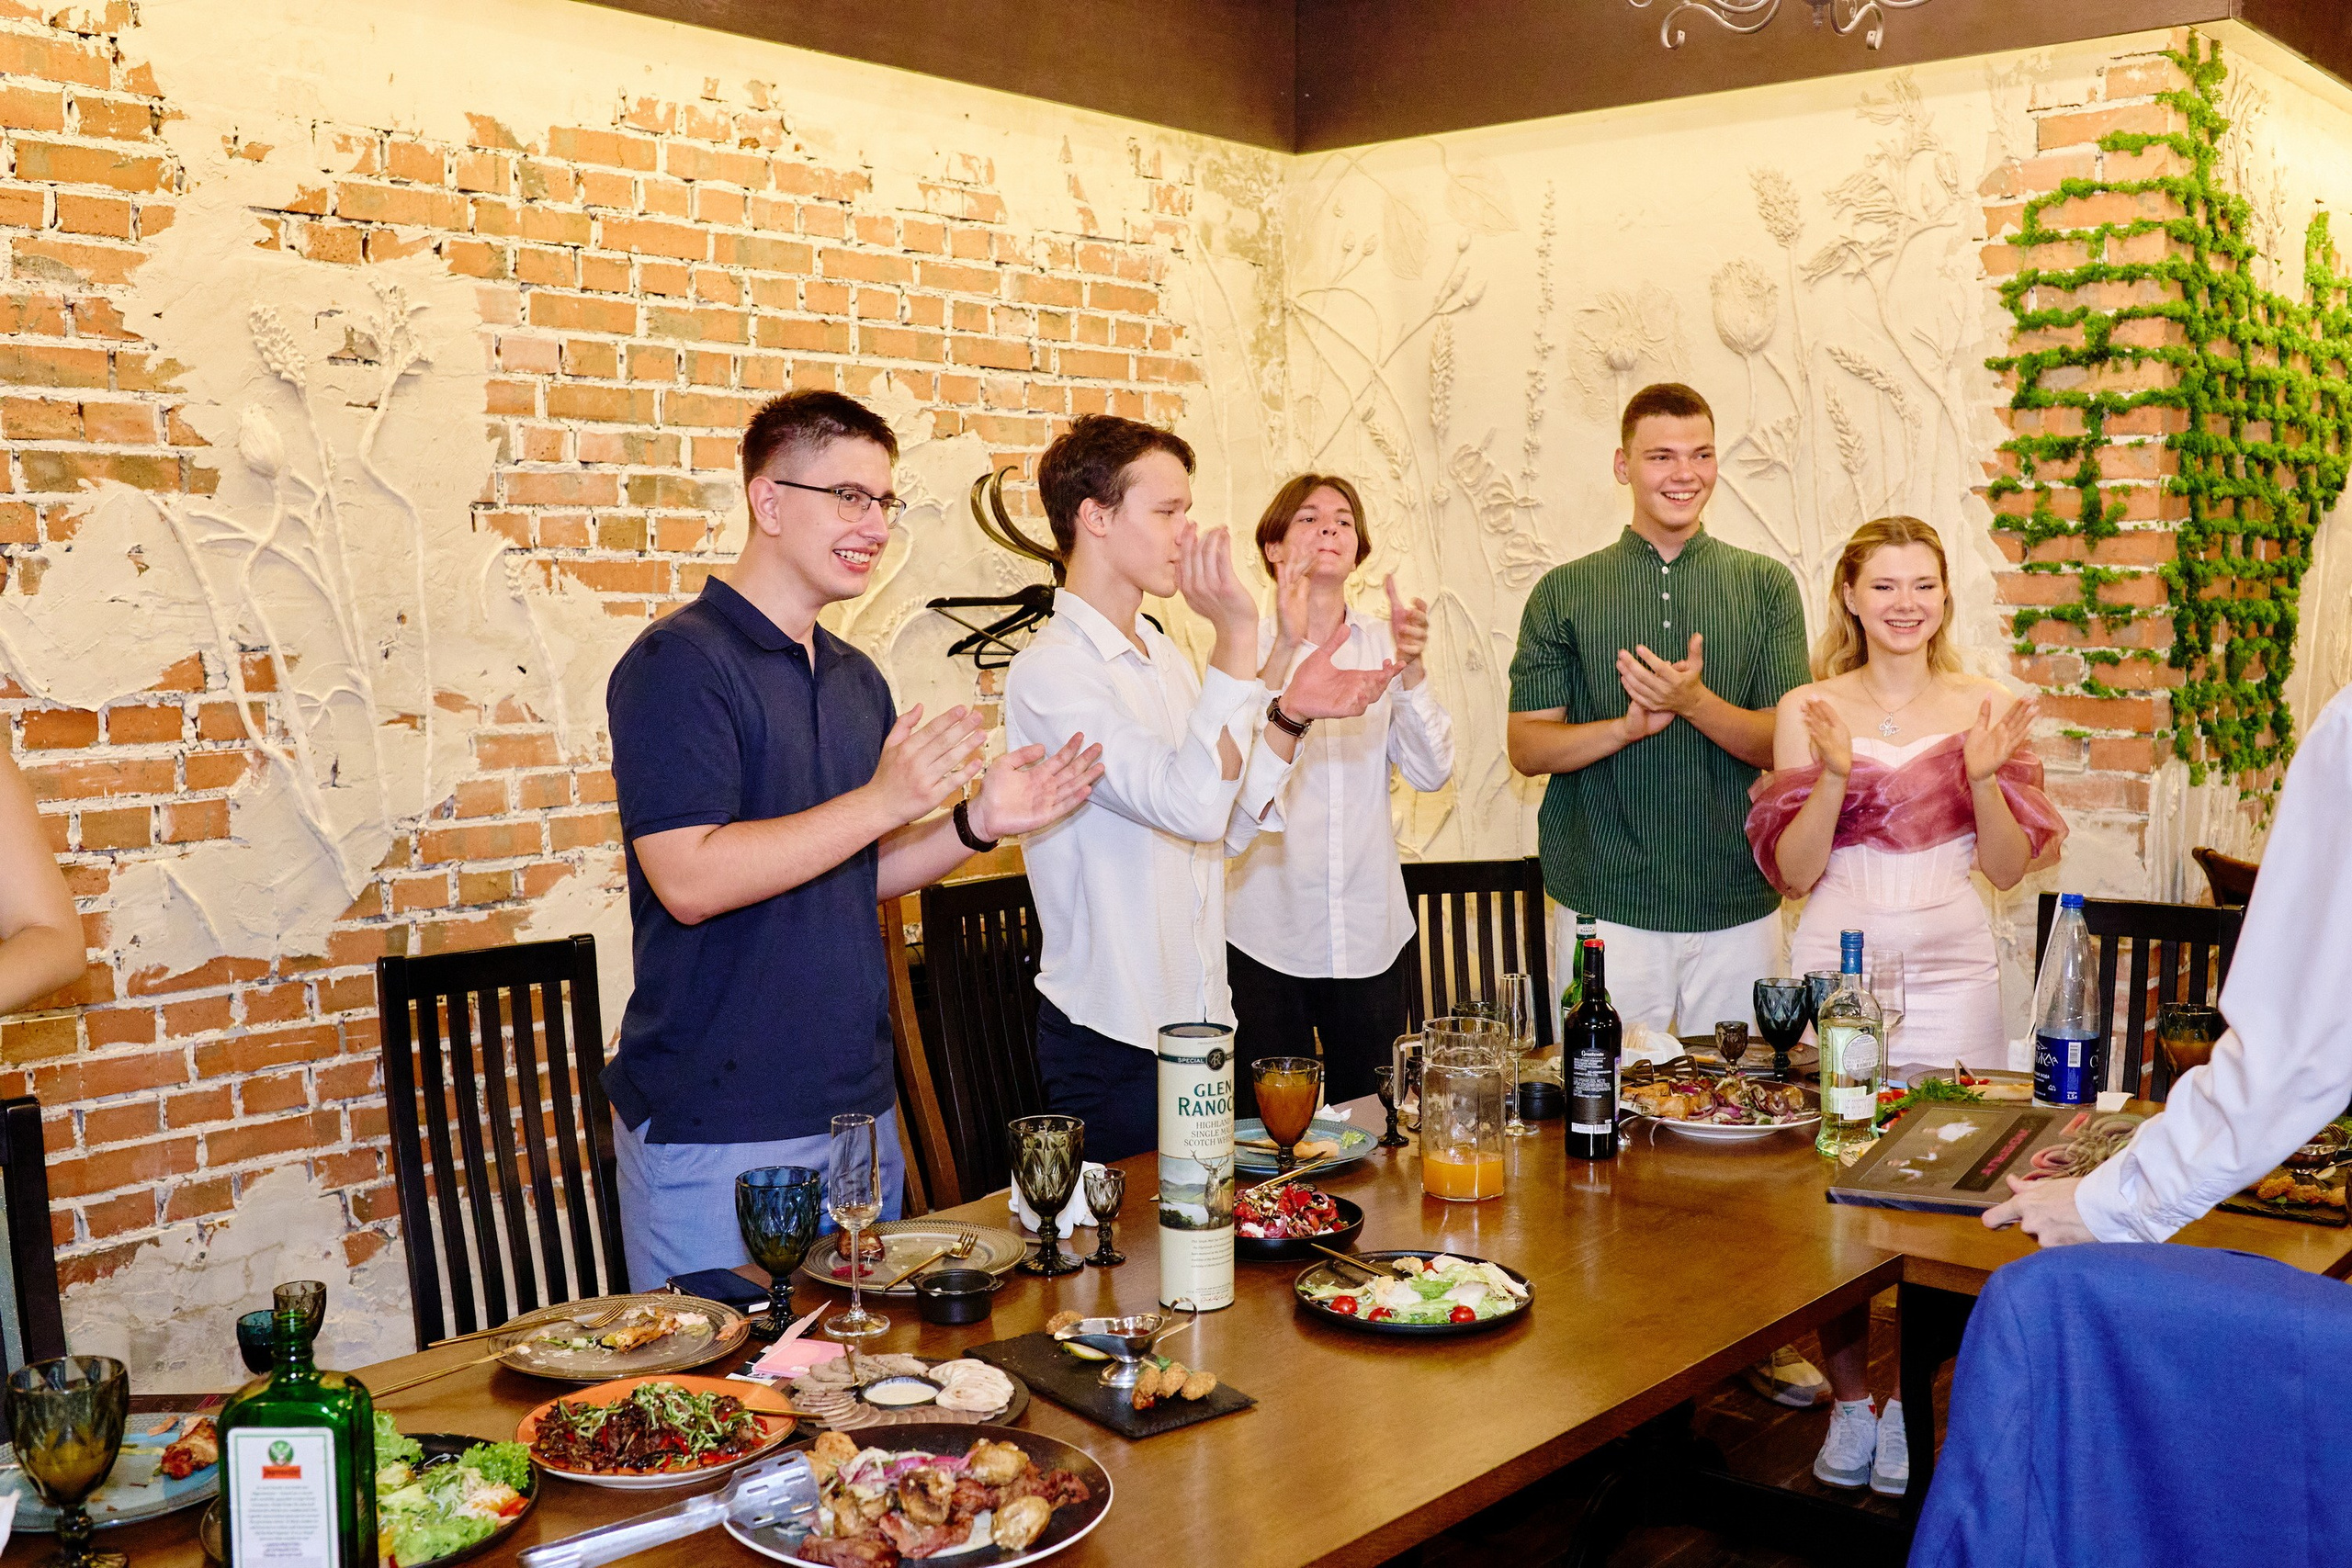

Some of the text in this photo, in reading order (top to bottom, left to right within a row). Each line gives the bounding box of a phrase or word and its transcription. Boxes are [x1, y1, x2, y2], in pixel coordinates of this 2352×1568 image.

[1193, 1078, 1232, 1098] GLEN
[1191, 1128, 1220, 1138] SINGLE
[1183, 1137, 1216, 1147] SCOTCH
